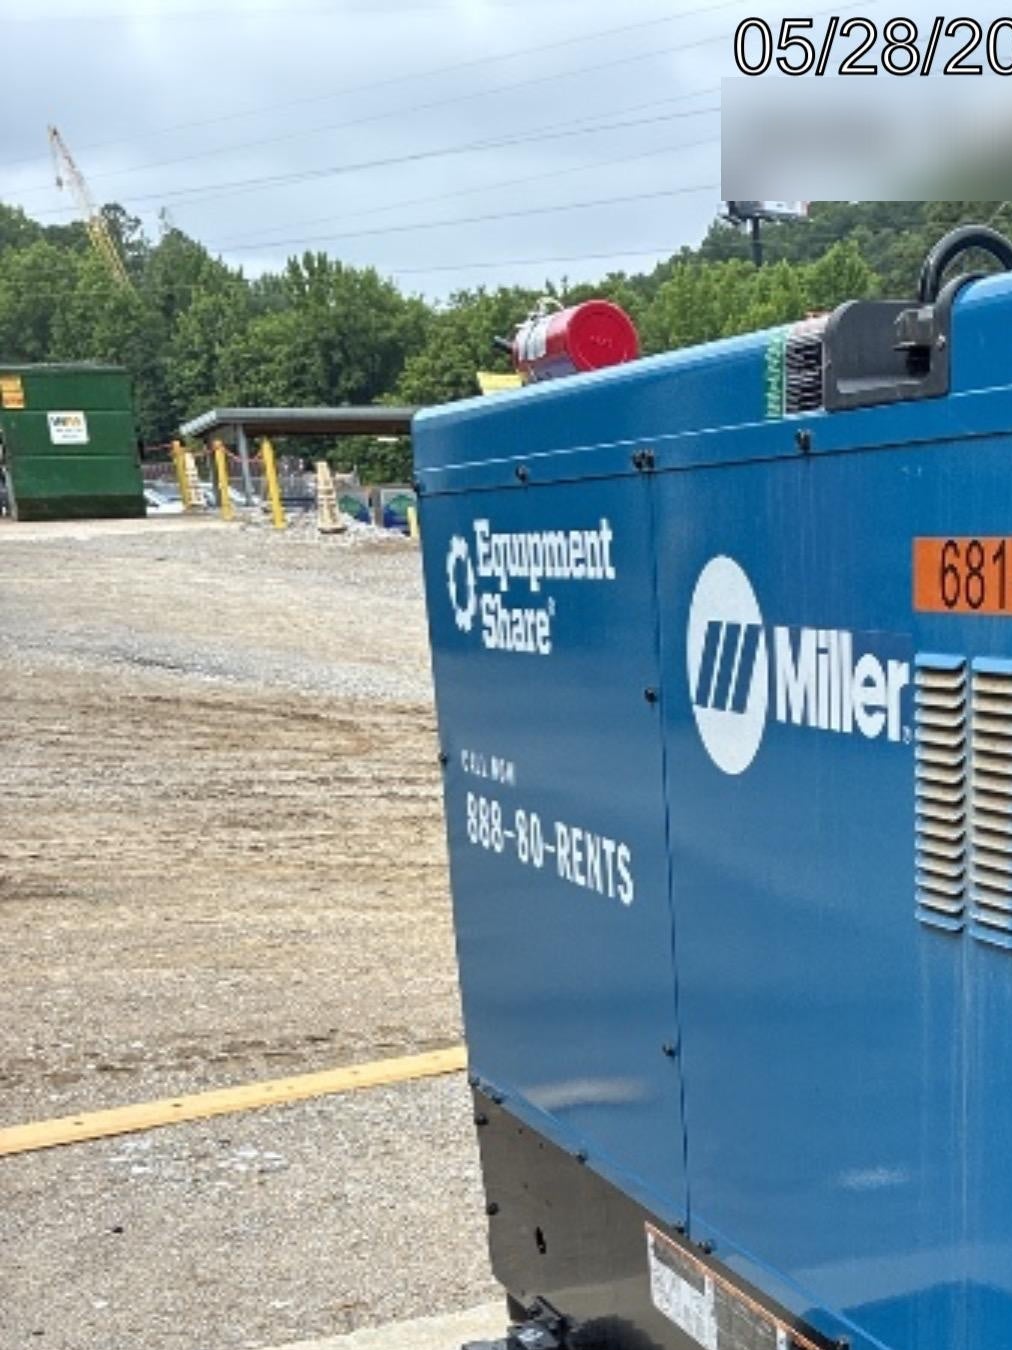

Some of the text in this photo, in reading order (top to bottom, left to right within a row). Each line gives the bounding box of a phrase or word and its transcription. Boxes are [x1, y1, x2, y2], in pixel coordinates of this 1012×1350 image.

[480, 593, 552, 655] Share
[774, 626, 910, 742] Miller
[466, 791, 634, 907] 888-80-RENTS
